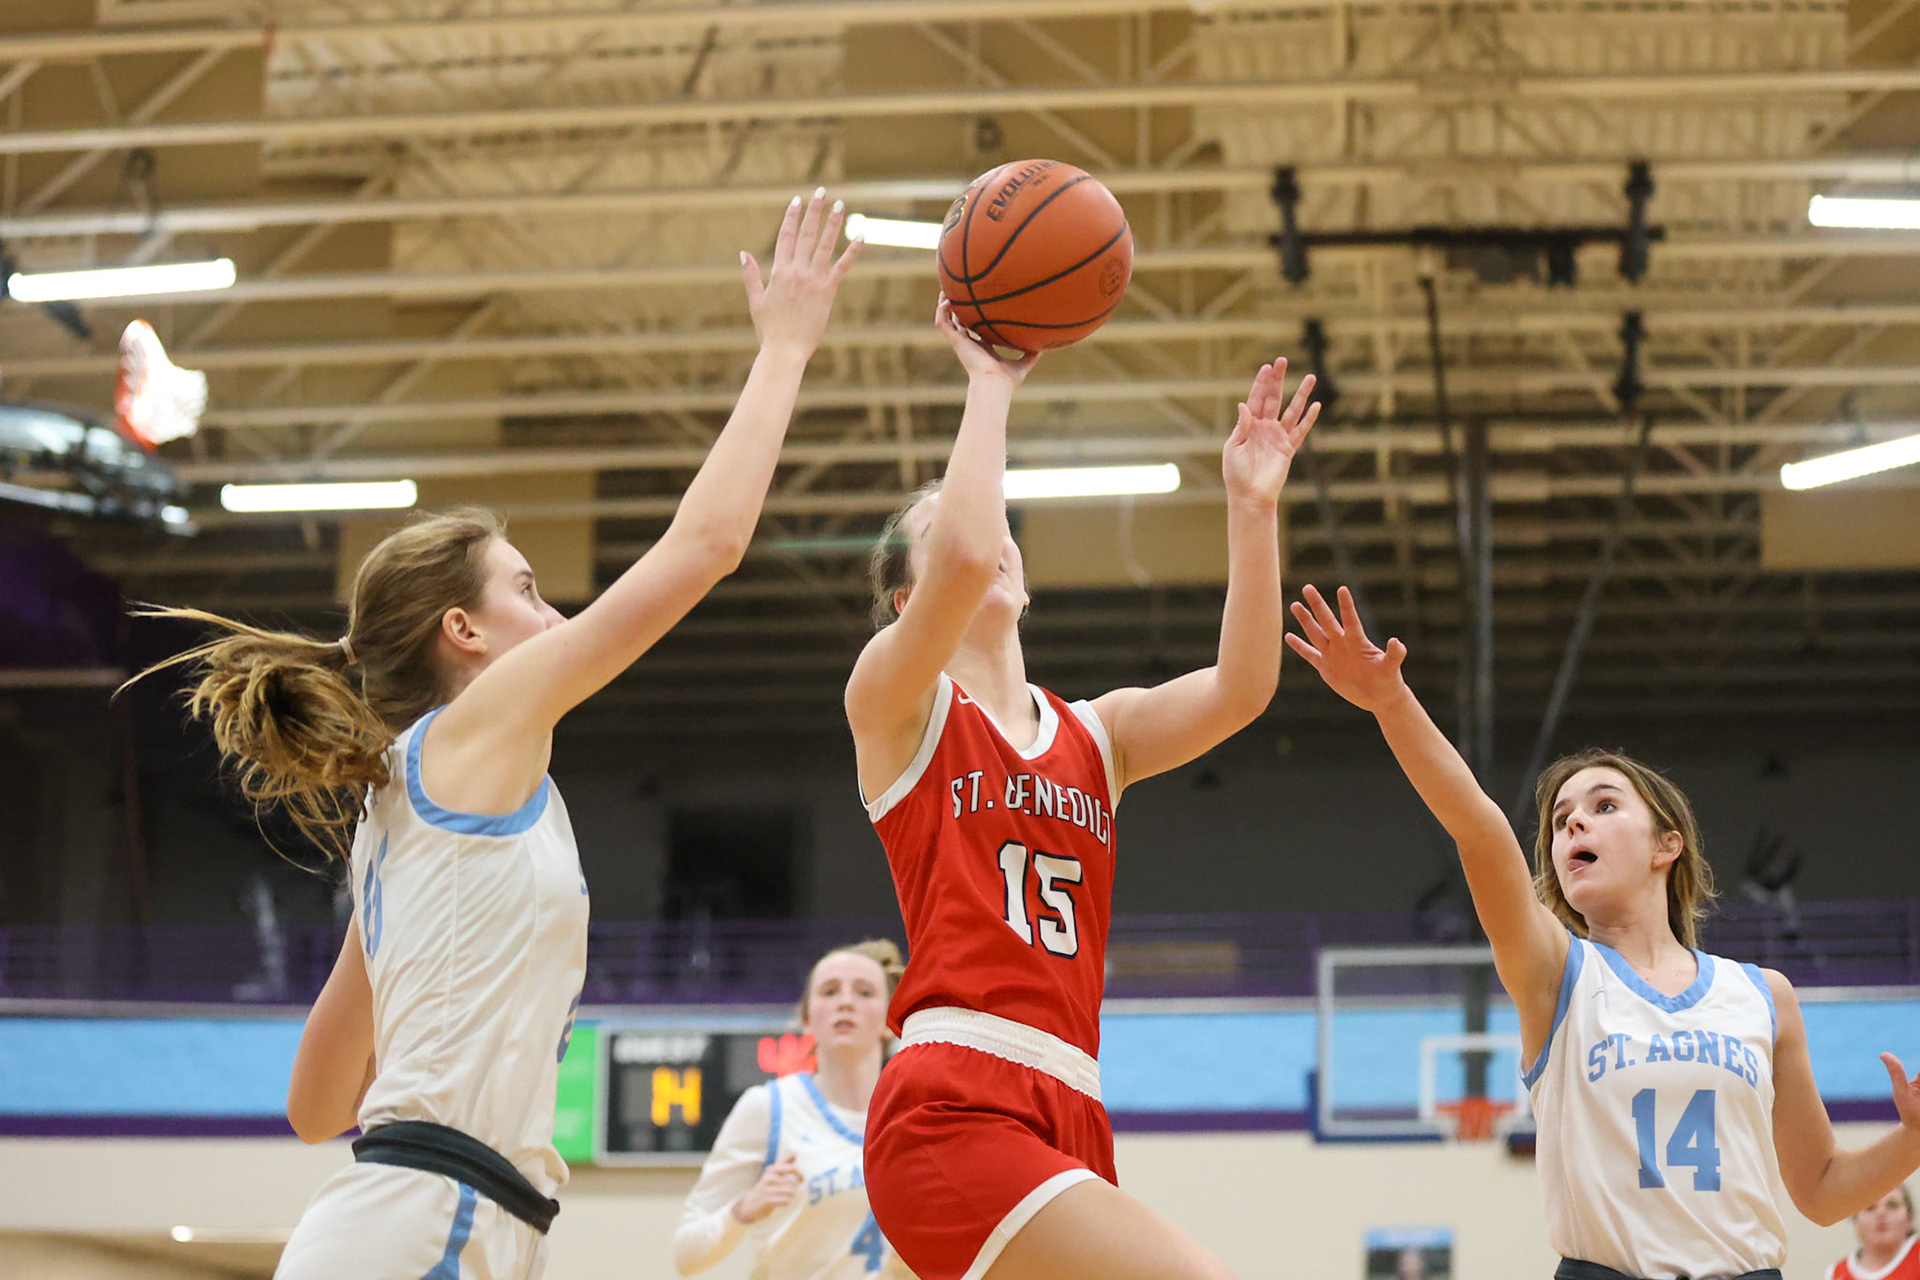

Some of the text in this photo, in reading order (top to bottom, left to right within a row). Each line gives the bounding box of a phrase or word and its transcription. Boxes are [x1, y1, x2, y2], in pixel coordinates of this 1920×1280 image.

[986, 161, 1060, 222] EVOLUTI
[951, 770, 994, 819] ST.
[997, 839, 1082, 959] 15
[1588, 1030, 1758, 1089] ST. AGNES
[1632, 1088, 1721, 1192] 14
[850, 1208, 884, 1273] 4
